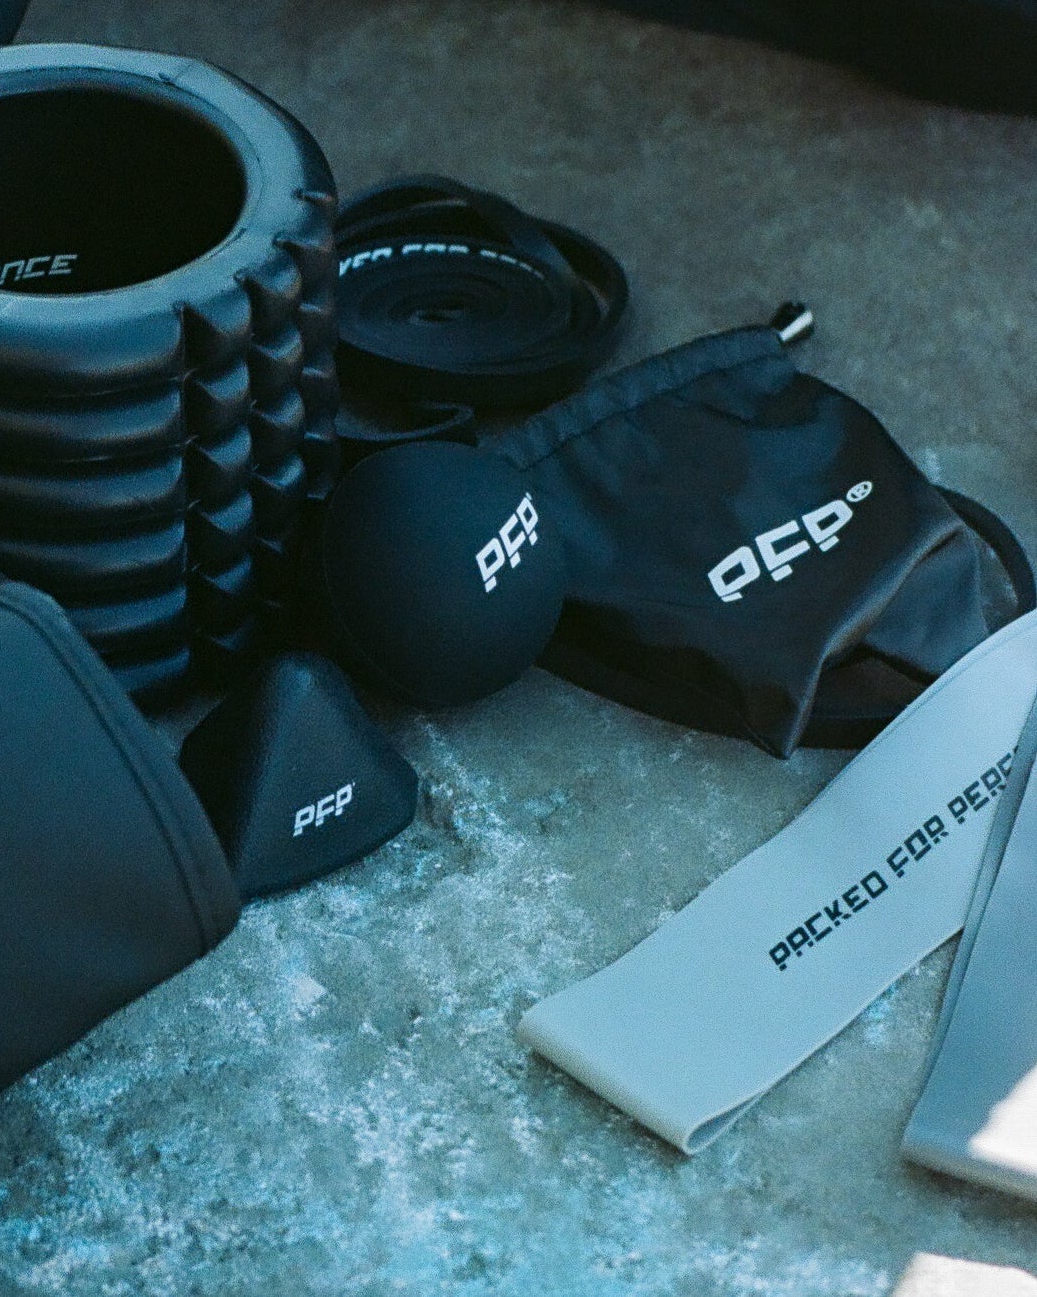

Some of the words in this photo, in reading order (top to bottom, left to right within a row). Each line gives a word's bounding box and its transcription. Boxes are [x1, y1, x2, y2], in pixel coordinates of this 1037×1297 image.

[475, 495, 539, 593] PFP
[292, 783, 353, 837] PFP
[768, 869, 889, 972] PACKED
[886, 814, 950, 879] FOR
[947, 744, 1019, 825] PERF
